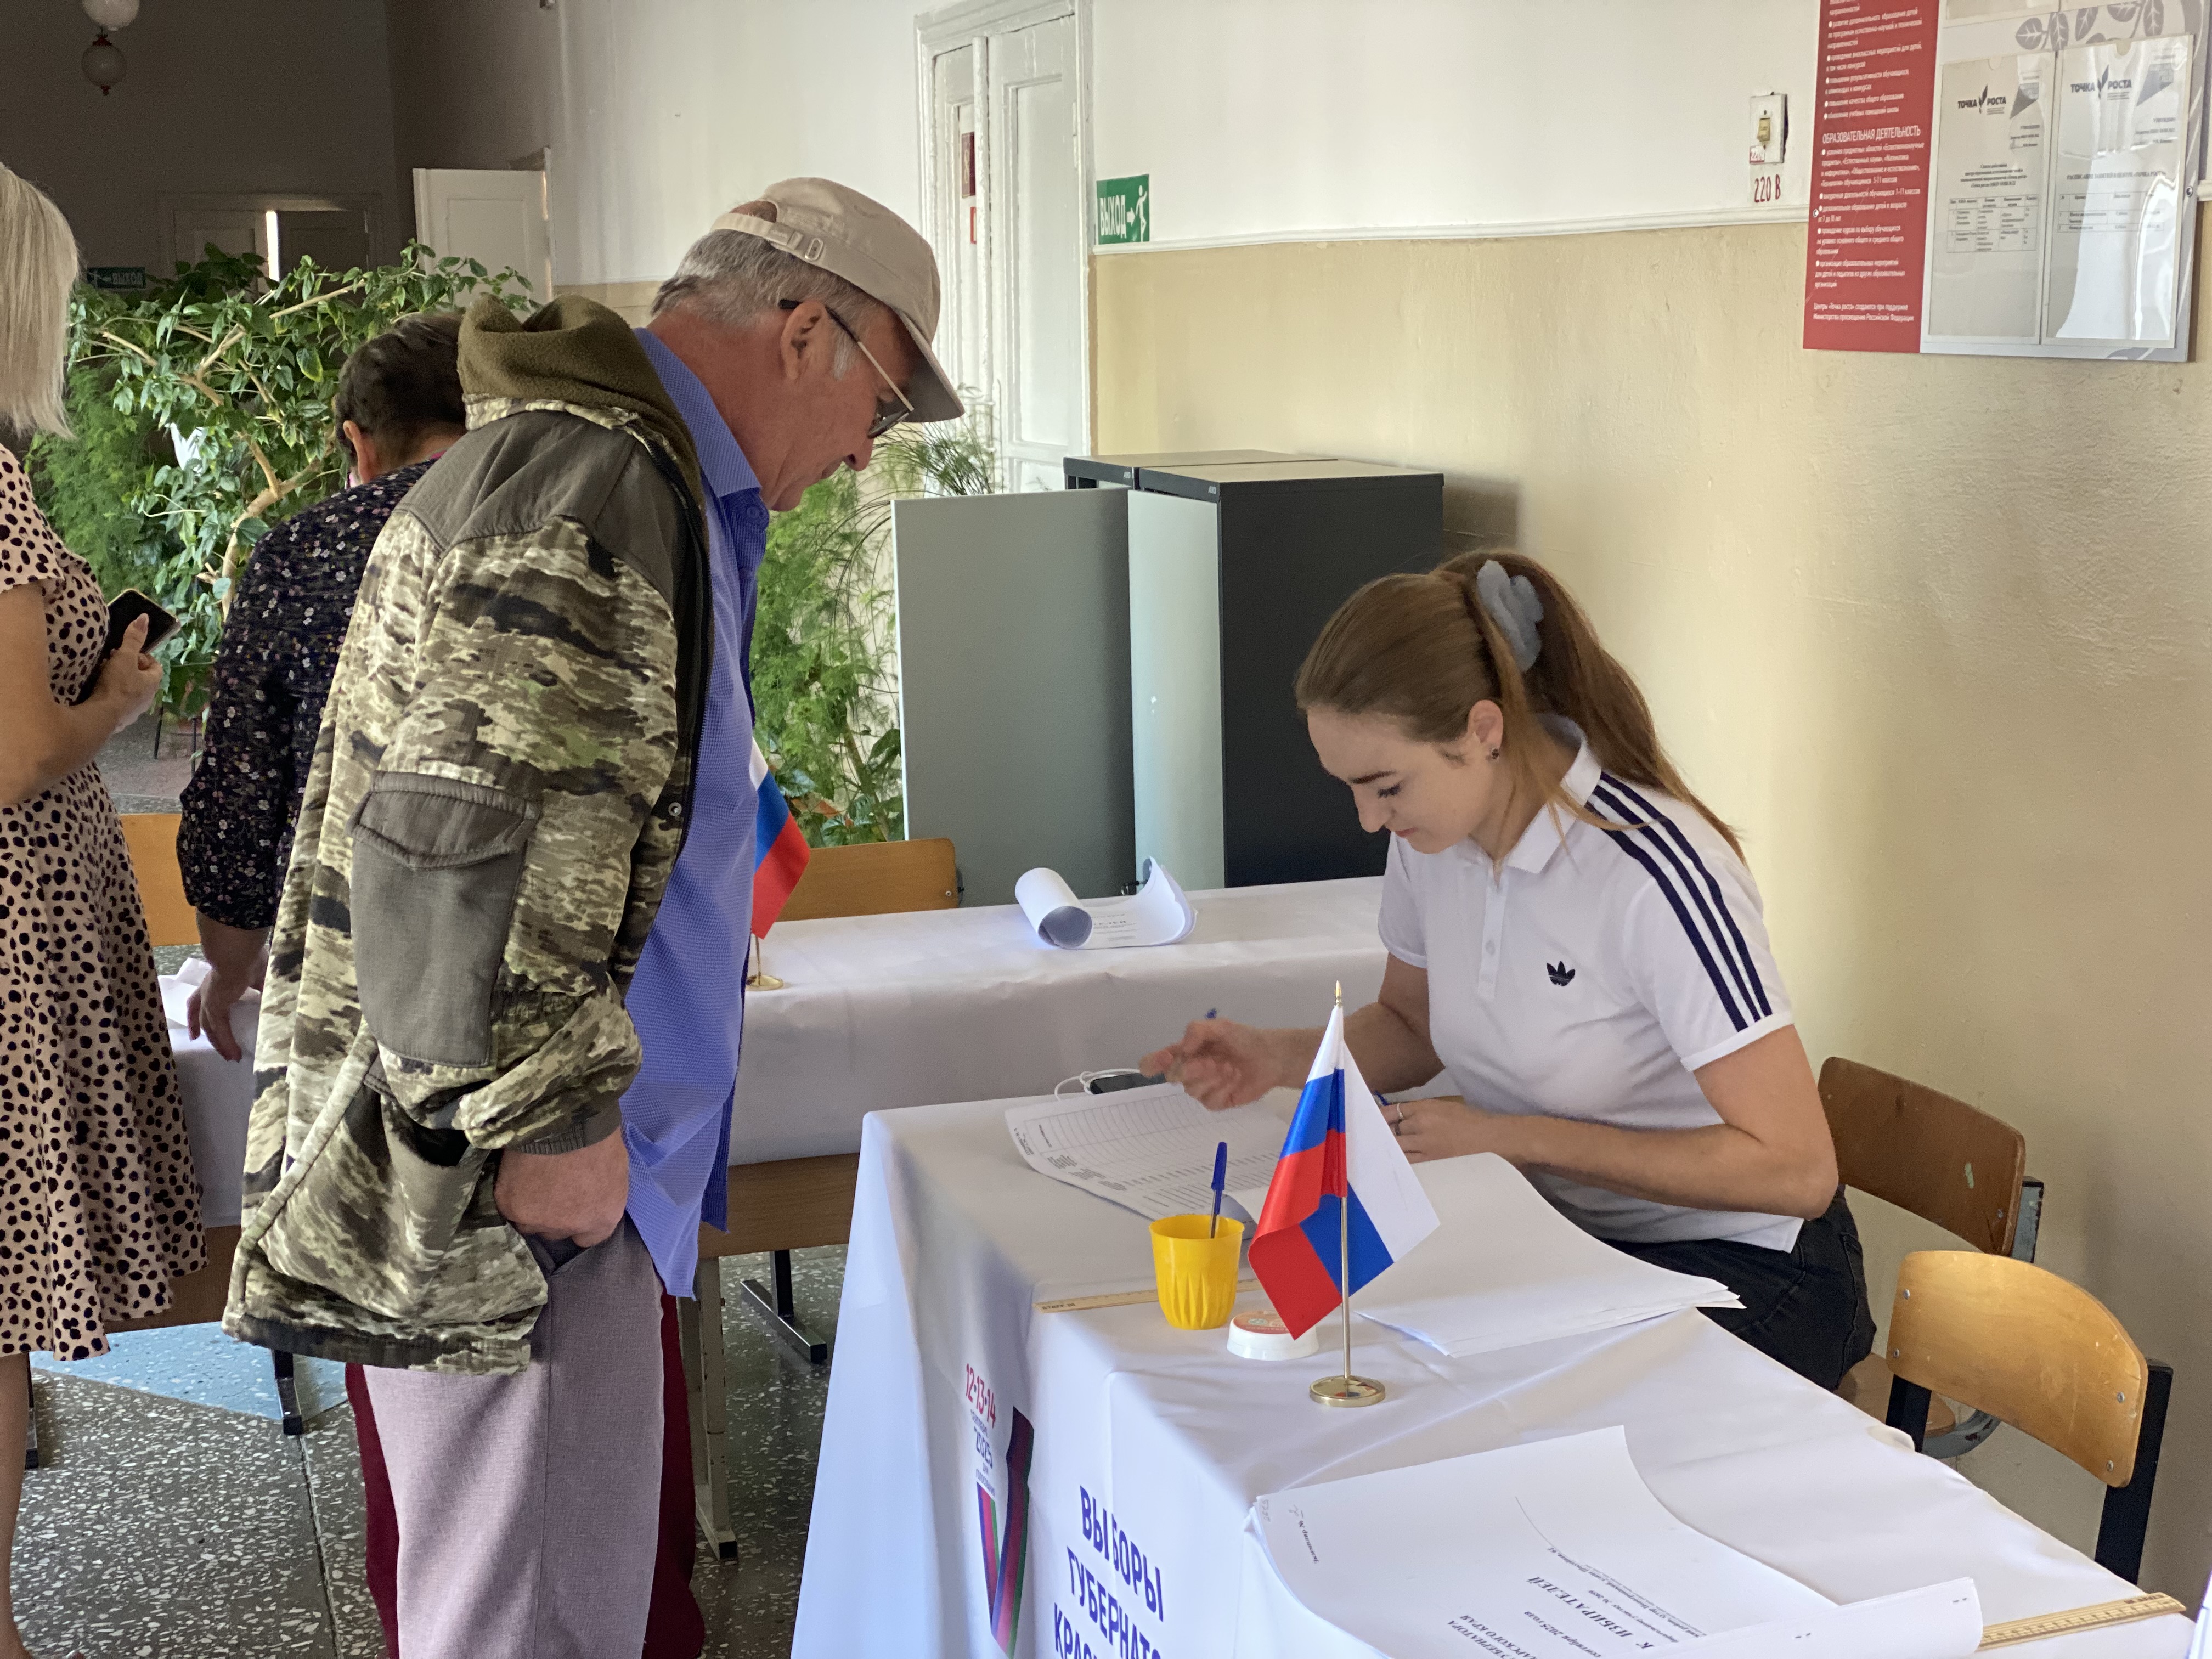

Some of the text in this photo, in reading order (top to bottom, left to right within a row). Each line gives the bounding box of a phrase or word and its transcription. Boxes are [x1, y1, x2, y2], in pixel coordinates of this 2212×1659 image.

[2070, 79, 2132, 93] ТОЧКА РОСТА
[1957, 96, 2006, 109] ТОЧКА РОСТА
[1822, 125, 1921, 144] ОБРАЗОВАТЕЛЬНАЯ ДЕЯТЕЛЬНОСТЬ
[1754, 174, 1781, 202] 220 В
[1099, 194, 1127, 239] ВЫХОД
[1080, 1485, 1164, 1623] ВЫБОРЫ
[1066, 1545, 1161, 1659] ГУБЕРНАТ
[1526, 1576, 1634, 1638] ИЗБИРАТЕЛЕЙ
[1460, 1615, 1490, 1632] КРАЯ
[1540, 1623, 1563, 1636] 2025
[1447, 1620, 1515, 1659] УБЕРНАТОРА
